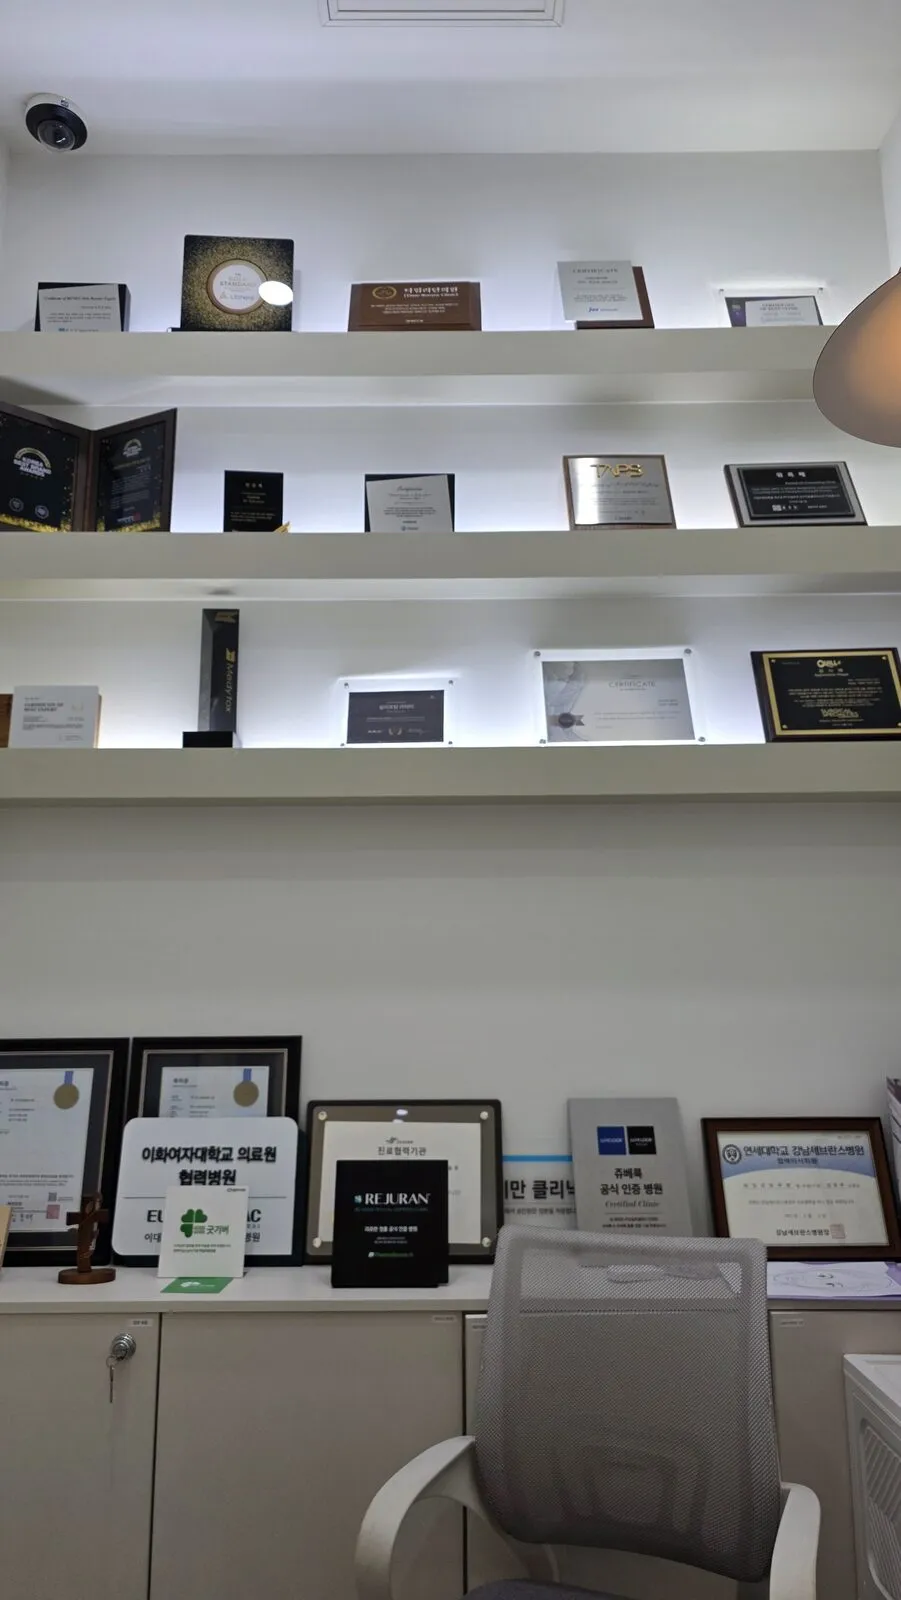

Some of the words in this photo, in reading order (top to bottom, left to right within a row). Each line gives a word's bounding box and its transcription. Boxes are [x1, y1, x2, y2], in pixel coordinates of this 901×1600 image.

[608, 680, 656, 688] CERTIFICATE
[142, 1146, 234, 1163] 이화여자대학교
[237, 1146, 277, 1163] 의료원
[378, 1146, 426, 1156] 진료협력기관
[743, 1146, 788, 1156] 연세대학교
[792, 1146, 864, 1156] 강남세브란스병원
[179, 1168, 236, 1186] 협력병원
[614, 1168, 642, 1179] 쥬베룩
[600, 1184, 619, 1196] 공식
[622, 1183, 641, 1195] 인증
[644, 1182, 664, 1195] 병원
[364, 1192, 429, 1204] REJURAN
